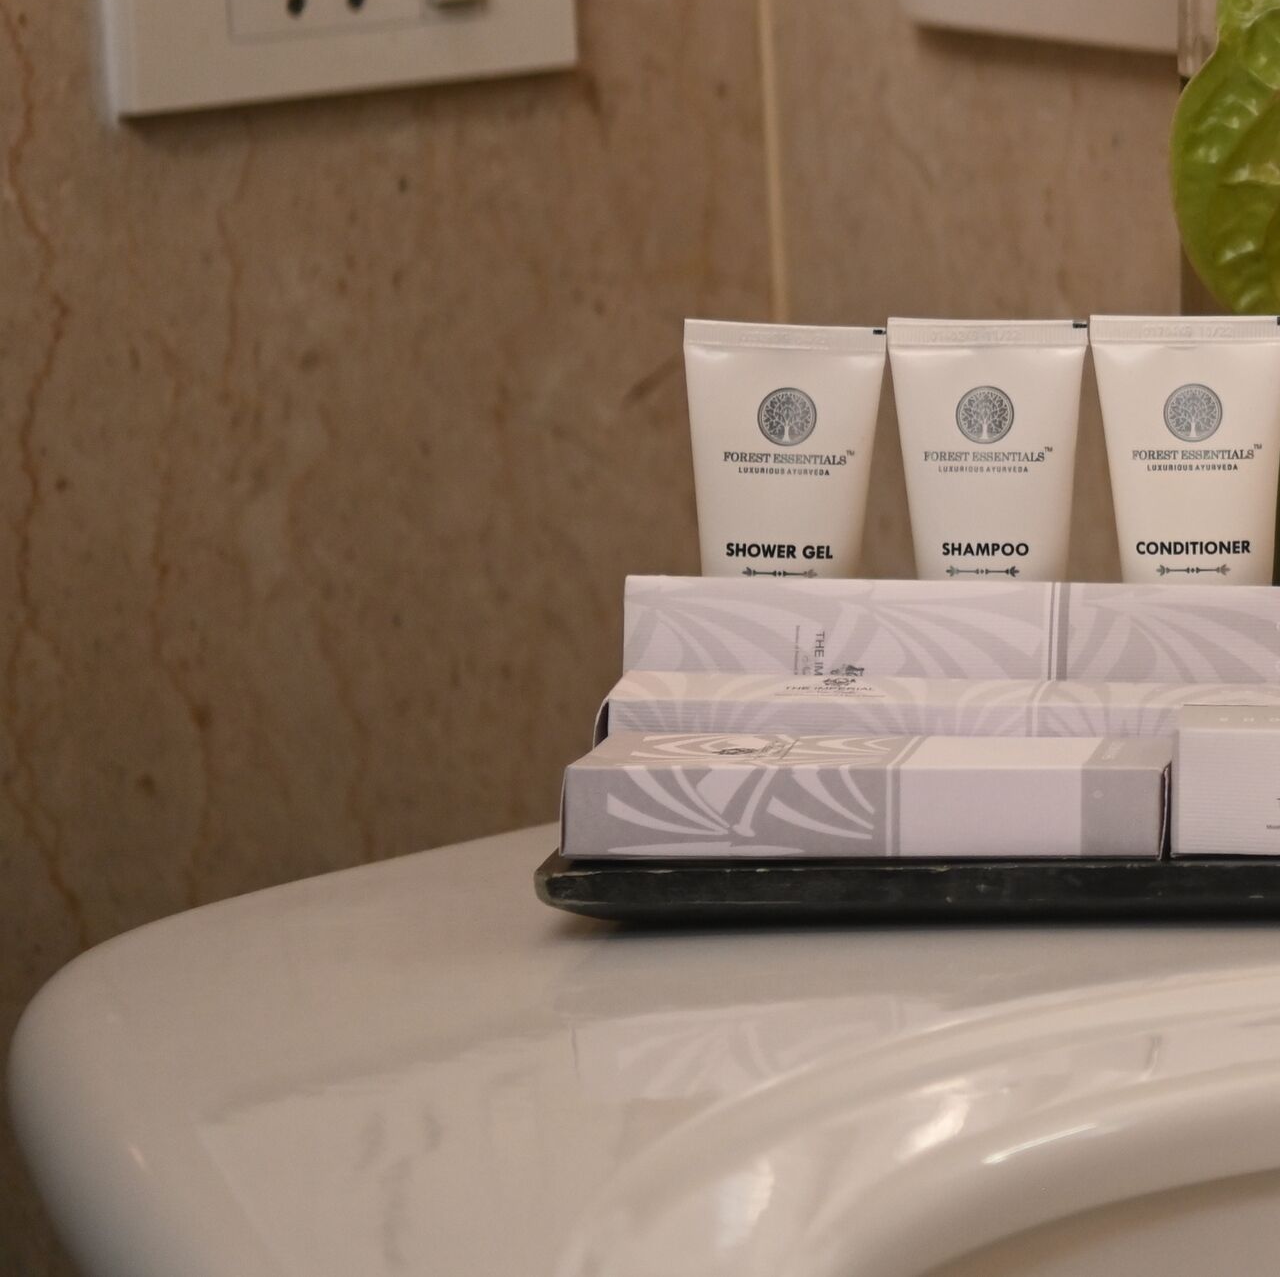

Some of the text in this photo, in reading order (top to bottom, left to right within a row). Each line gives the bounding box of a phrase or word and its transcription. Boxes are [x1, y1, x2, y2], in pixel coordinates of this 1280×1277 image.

[723, 451, 770, 463] FOREST
[923, 451, 970, 462] FOREST
[1132, 449, 1178, 461] FOREST
[738, 467, 830, 476] LUXURIOUS AYURVEDA
[938, 465, 985, 473] LUXURIOUS
[726, 543, 833, 559] SHOWER GEL
[942, 542, 1029, 557] SHAMPOO
[1136, 540, 1251, 556] CONDITIONER
[814, 631, 825, 658] THE
